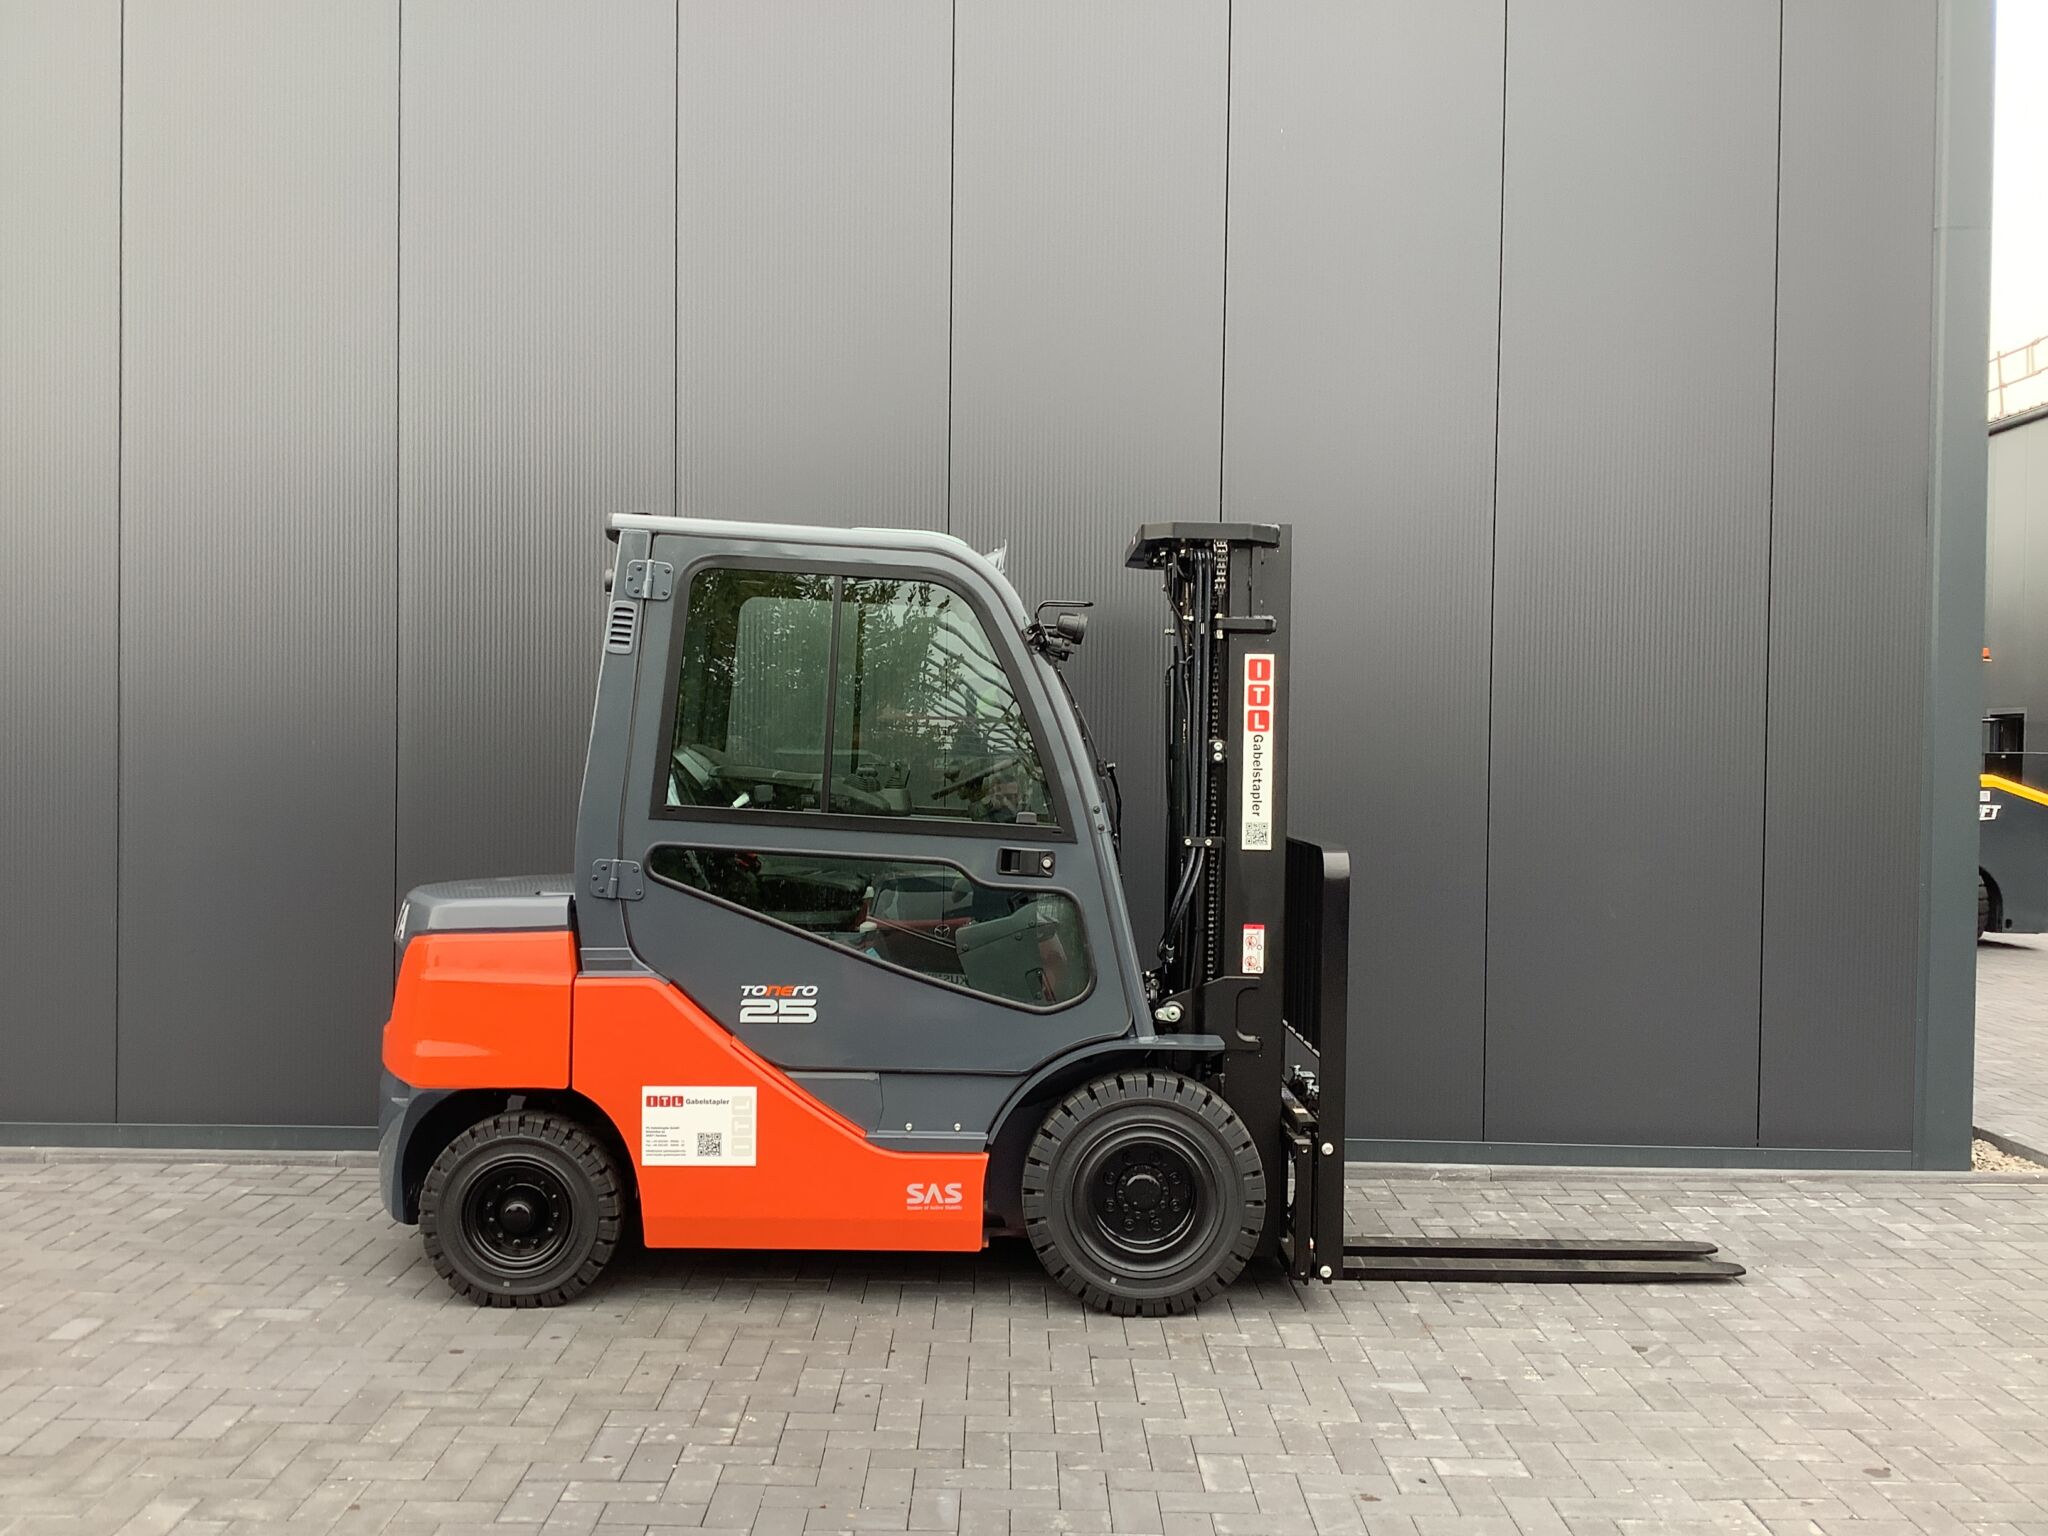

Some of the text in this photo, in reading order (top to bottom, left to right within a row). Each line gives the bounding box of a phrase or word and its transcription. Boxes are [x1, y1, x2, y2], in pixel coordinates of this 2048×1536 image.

[1249, 659, 1269, 817] ITL Gabelstapler
[1979, 804, 2002, 821] FT
[740, 998, 817, 1023] 25
[649, 1096, 730, 1107] ITL Gabelstapler
[906, 1183, 963, 1204] SAS
